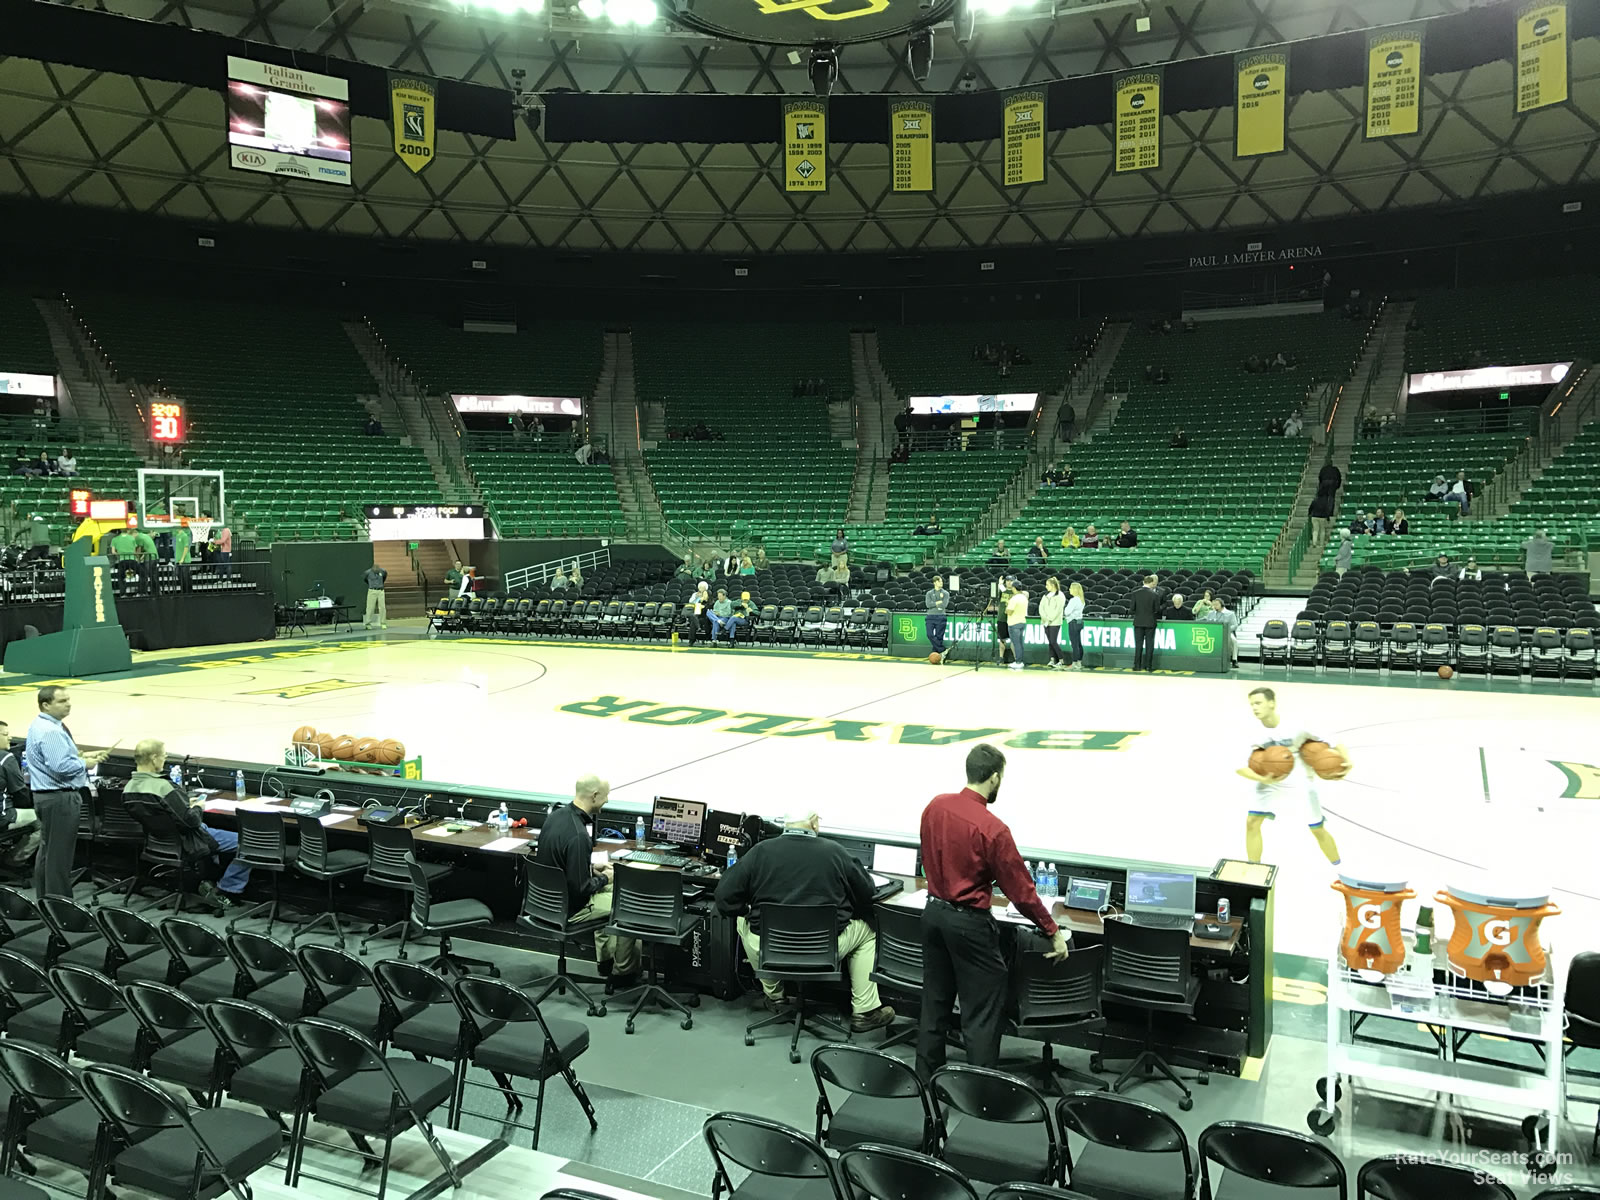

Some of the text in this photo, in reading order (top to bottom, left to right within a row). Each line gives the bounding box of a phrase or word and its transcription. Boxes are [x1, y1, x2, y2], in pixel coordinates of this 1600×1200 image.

[1369, 30, 1421, 48] BAYLOR
[1239, 54, 1287, 72] BAYLOR
[263, 64, 304, 81] Italian
[270, 76, 315, 92] Granite
[391, 79, 435, 97] BAYLOR
[1116, 74, 1160, 92] BAYLOR
[1373, 80, 1391, 88] 2004
[785, 101, 826, 113] BAYLOR
[891, 101, 932, 113] BAYLOR
[1004, 91, 1044, 107] BAYLOR
[1371, 119, 1390, 127] 2011
[400, 143, 430, 157] 2000
[241, 155, 261, 165] KIA
[275, 167, 310, 177] UNIVERSITY
[1189, 256, 1219, 267] PAUL
[1233, 250, 1275, 264] MEYER
[1278, 246, 1322, 260] ARENA
[154, 416, 178, 439] 30
[898, 617, 918, 641] BU
[942, 621, 993, 642] ELCOME
[1123, 627, 1177, 650] ANA
[1191, 627, 1215, 653] BU
[554, 693, 1148, 751] BAYLOR
[1357, 903, 1382, 930] G
[1484, 919, 1511, 946] G
